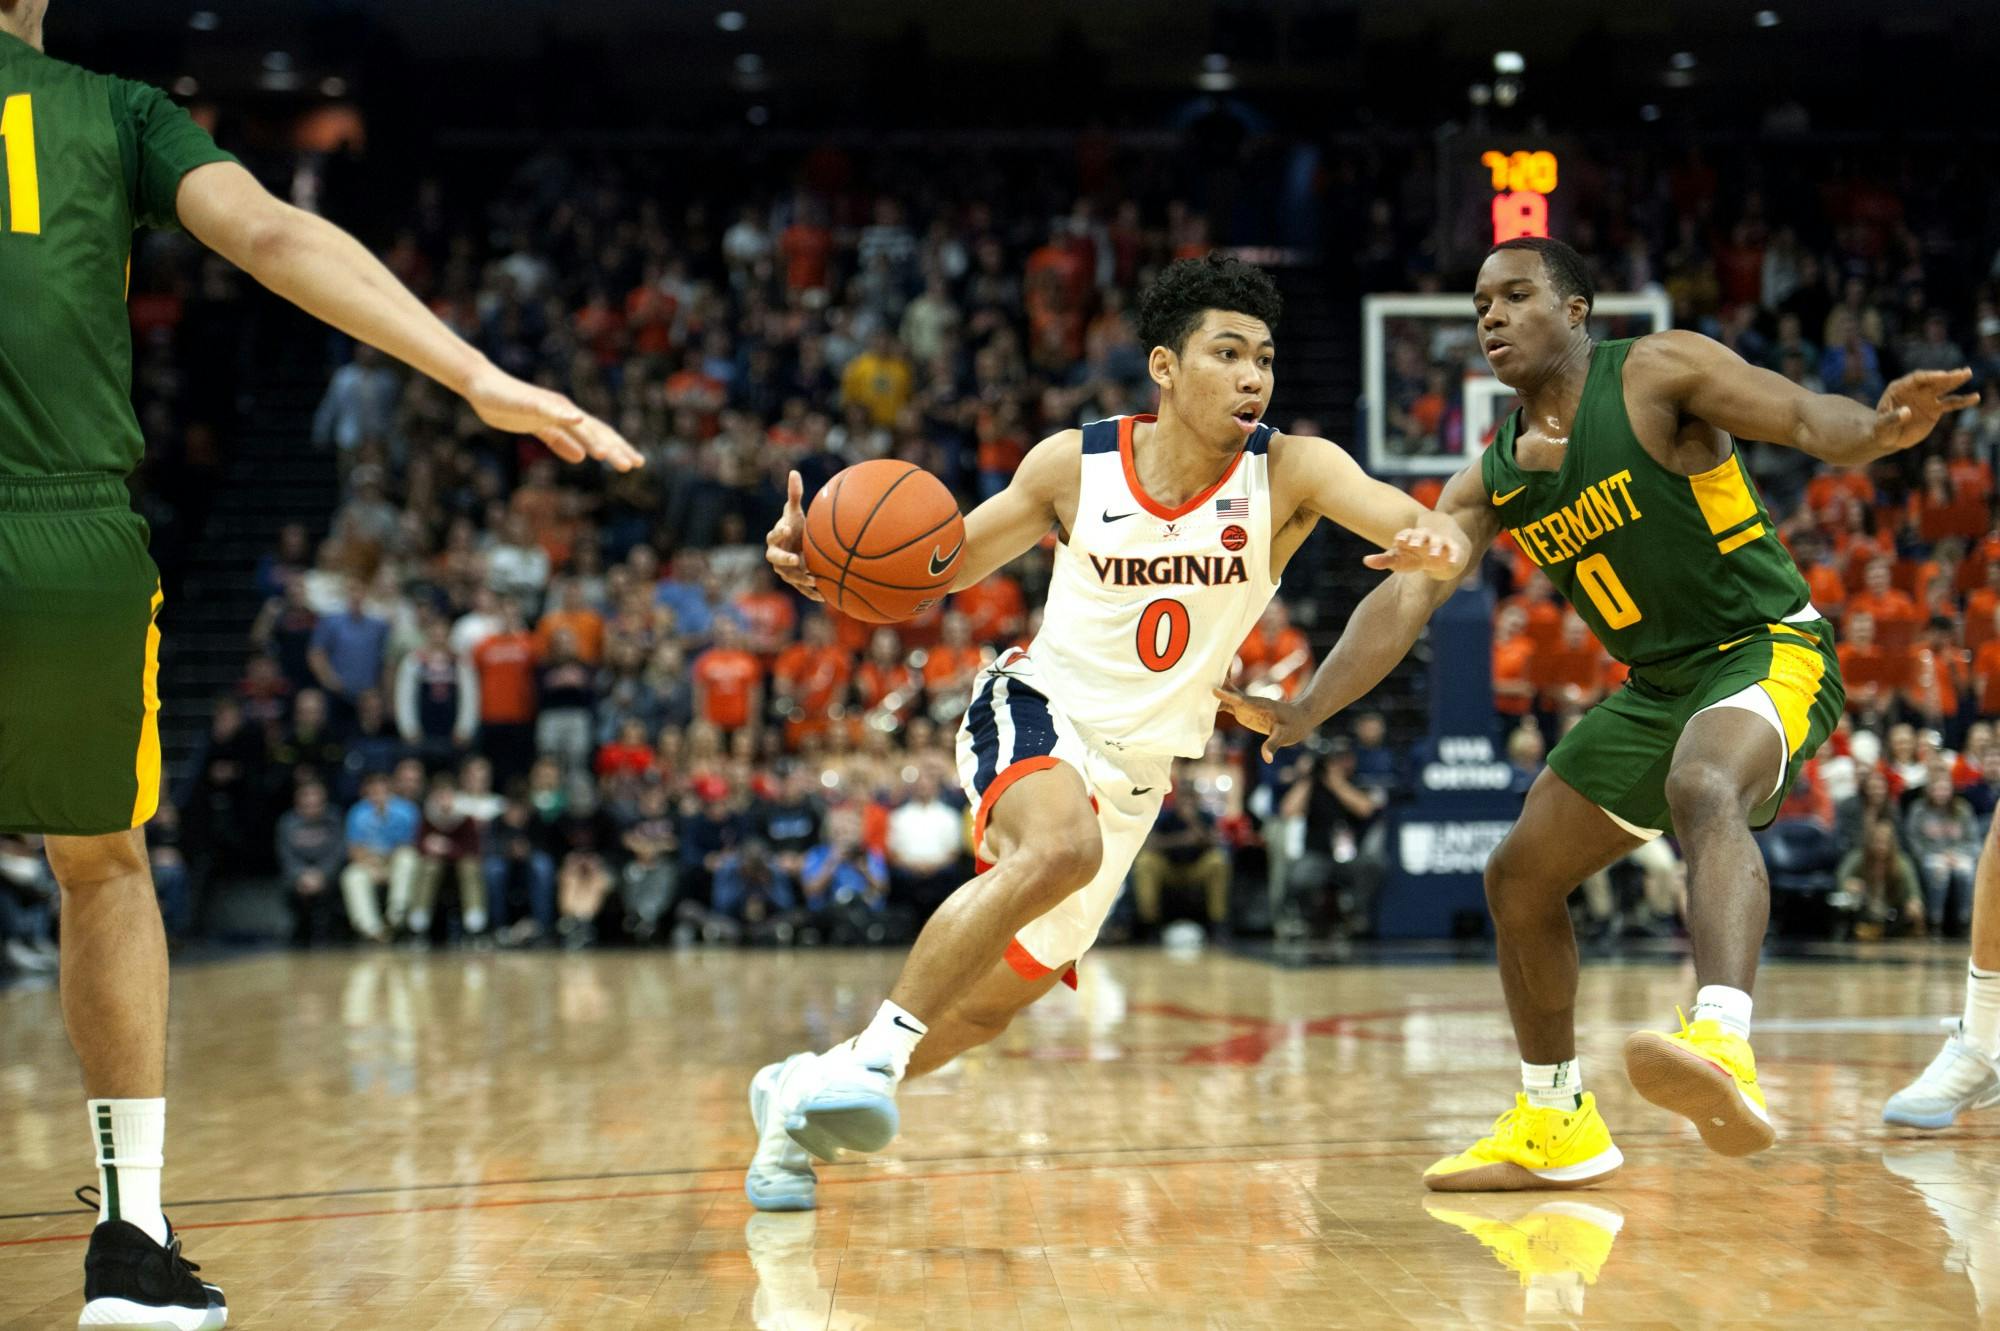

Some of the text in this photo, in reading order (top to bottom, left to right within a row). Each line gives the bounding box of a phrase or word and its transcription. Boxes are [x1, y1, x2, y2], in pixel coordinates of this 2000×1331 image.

[1509, 469, 1642, 567] VERMONT
[1088, 553, 1248, 586] VIRGINIA
[1576, 553, 1642, 630] 0
[1136, 598, 1190, 672] 0
